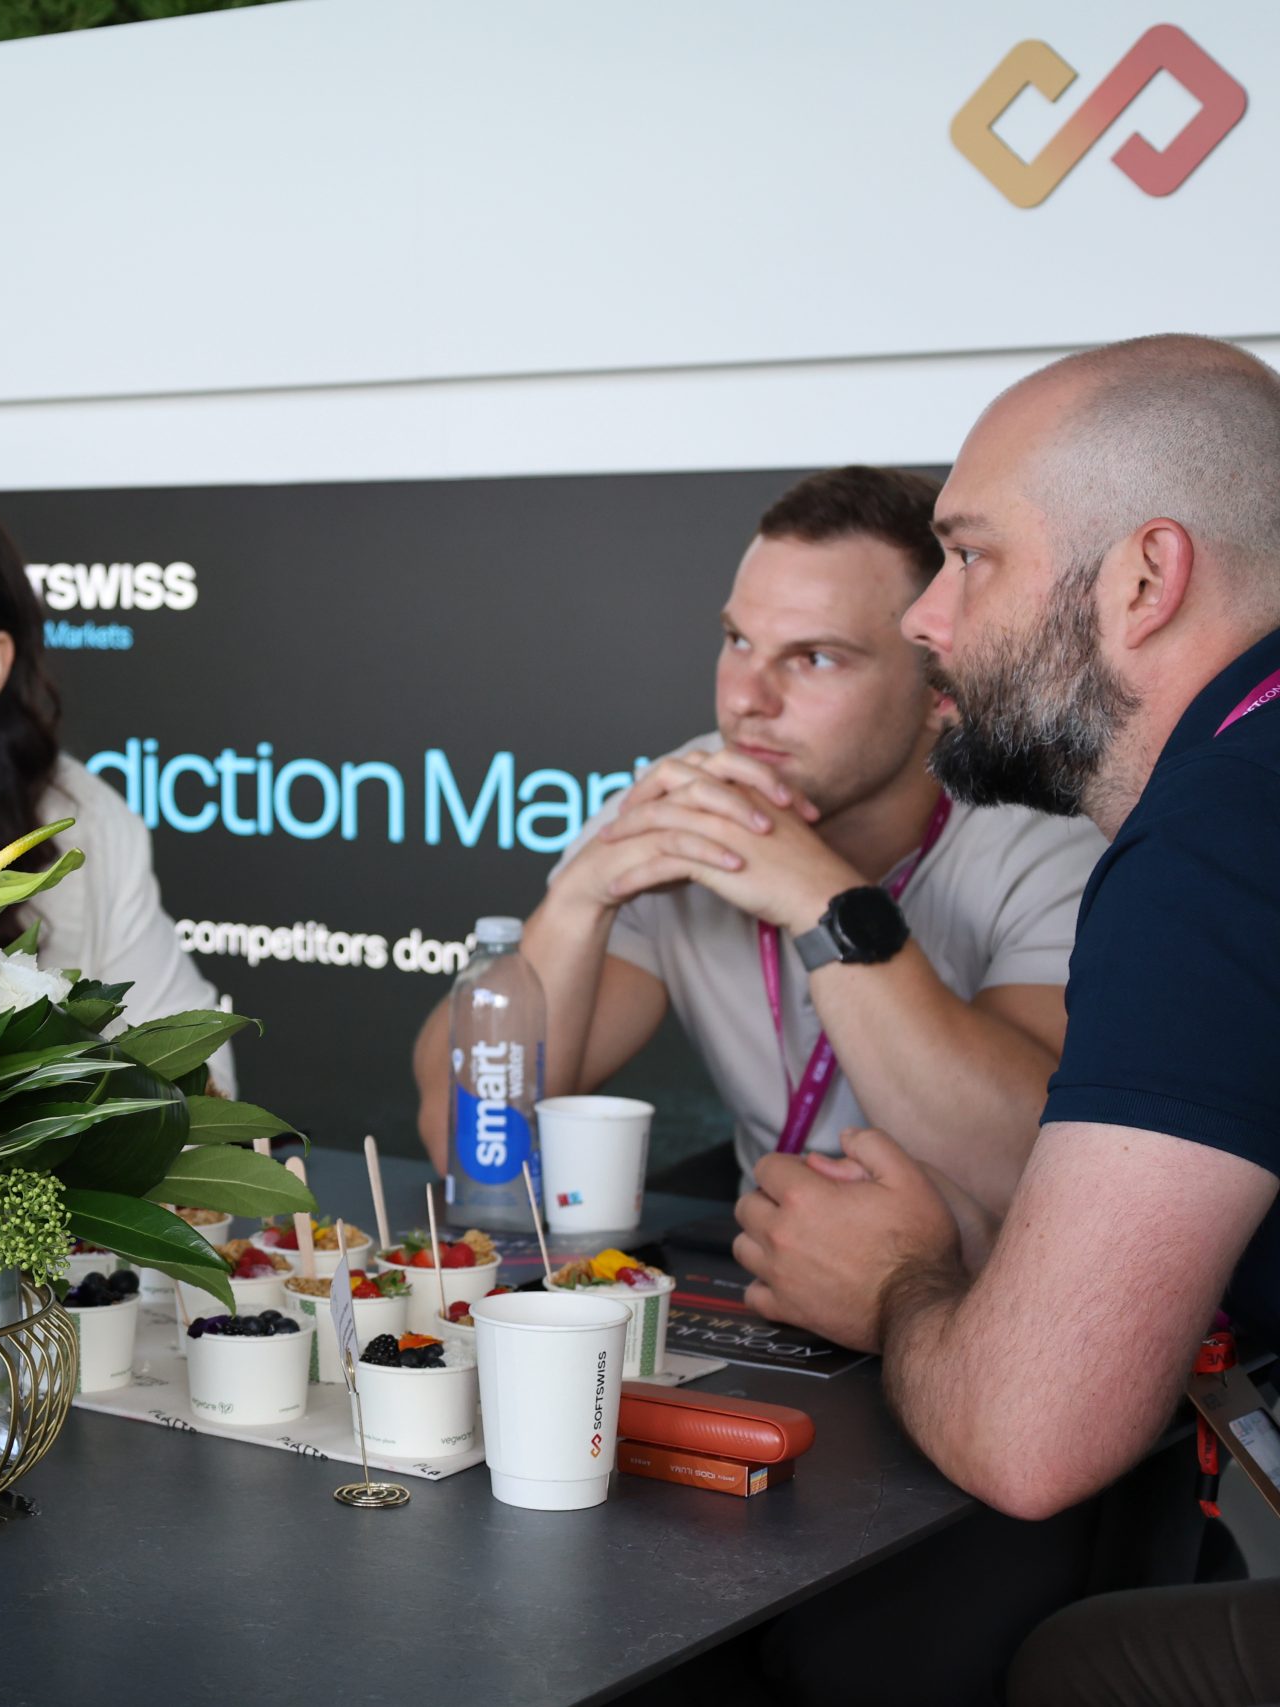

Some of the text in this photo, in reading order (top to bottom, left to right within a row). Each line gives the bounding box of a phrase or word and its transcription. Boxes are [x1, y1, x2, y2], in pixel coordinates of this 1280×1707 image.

[43, 619, 134, 650] Markets
[424, 748, 650, 853] Mar
[174, 919, 477, 975] competitors don'
[508, 1041, 523, 1098] water
[471, 1040, 507, 1167] smart
[593, 1351, 606, 1430] SOFTSWISS
[669, 1464, 693, 1476] ILUMA
[694, 1468, 716, 1480] IQOS
